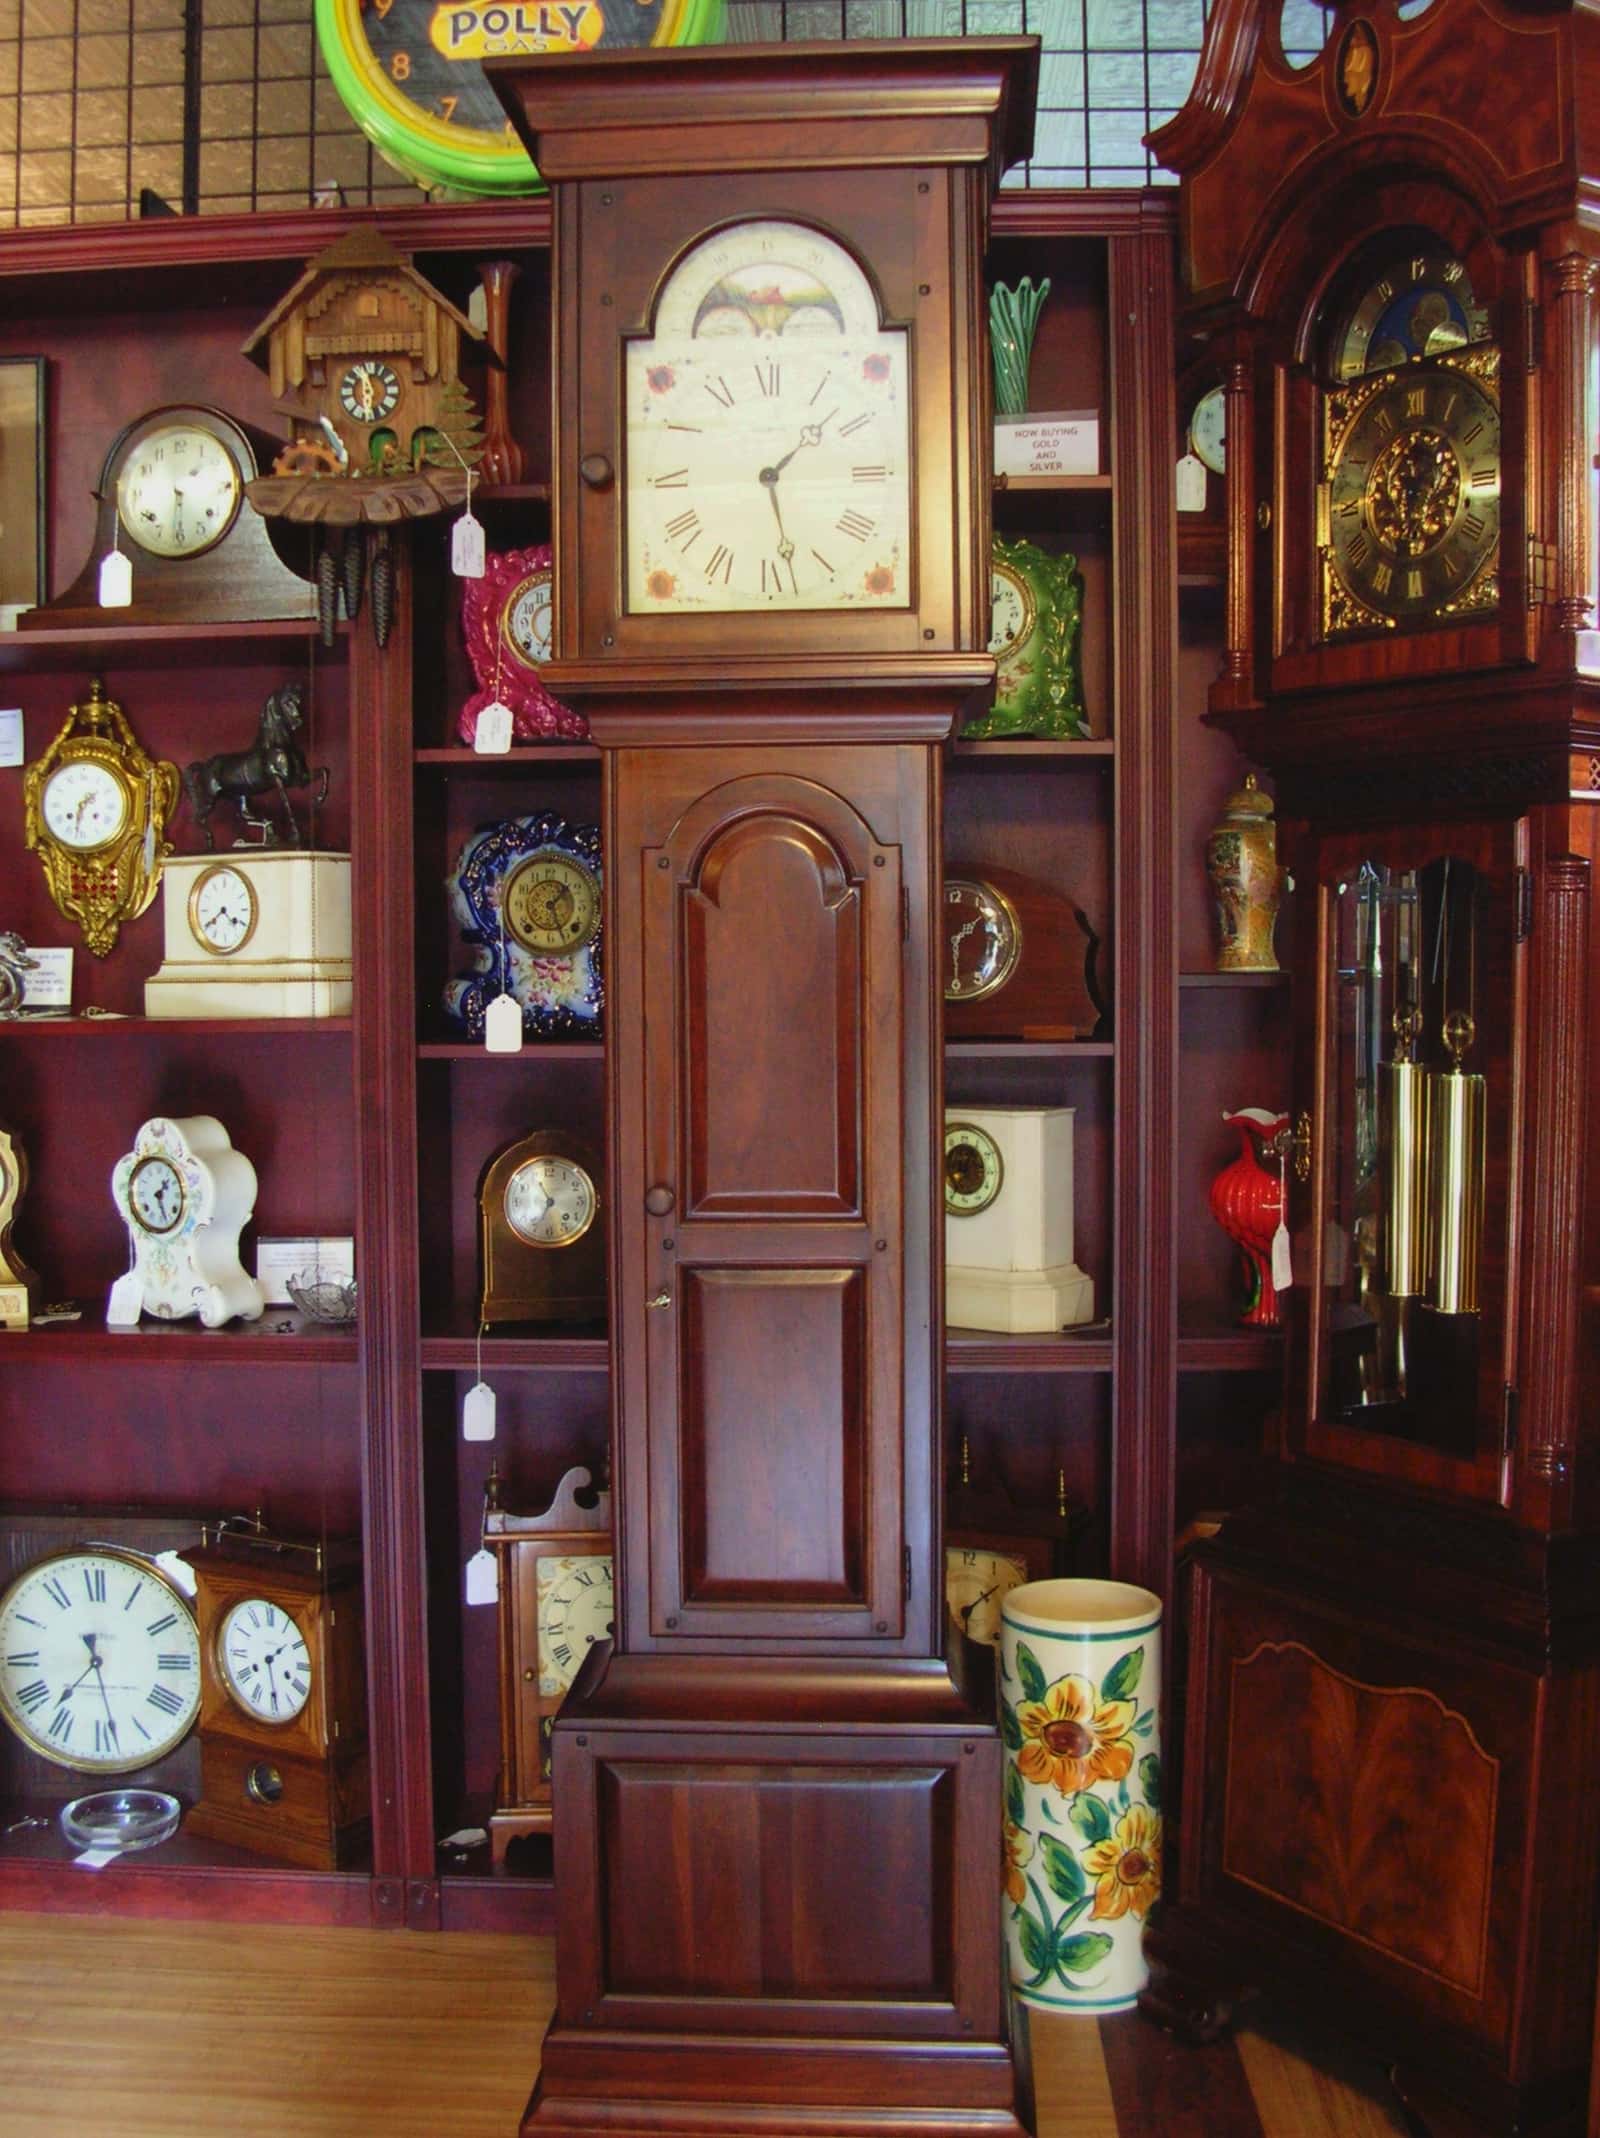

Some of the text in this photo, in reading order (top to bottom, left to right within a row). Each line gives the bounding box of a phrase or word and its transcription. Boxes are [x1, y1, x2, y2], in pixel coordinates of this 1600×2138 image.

[451, 5, 587, 46] POLLY
[484, 38, 548, 52] GAS
[391, 52, 410, 80] 8
[440, 96, 458, 124] 7
[1014, 426, 1078, 438] NOW BUYING
[1032, 439, 1060, 449] GOLD
[1035, 450, 1056, 460] AND
[1029, 461, 1063, 472] SILVER
[950, 890, 962, 903] 12
[963, 1551, 977, 1567] 12
